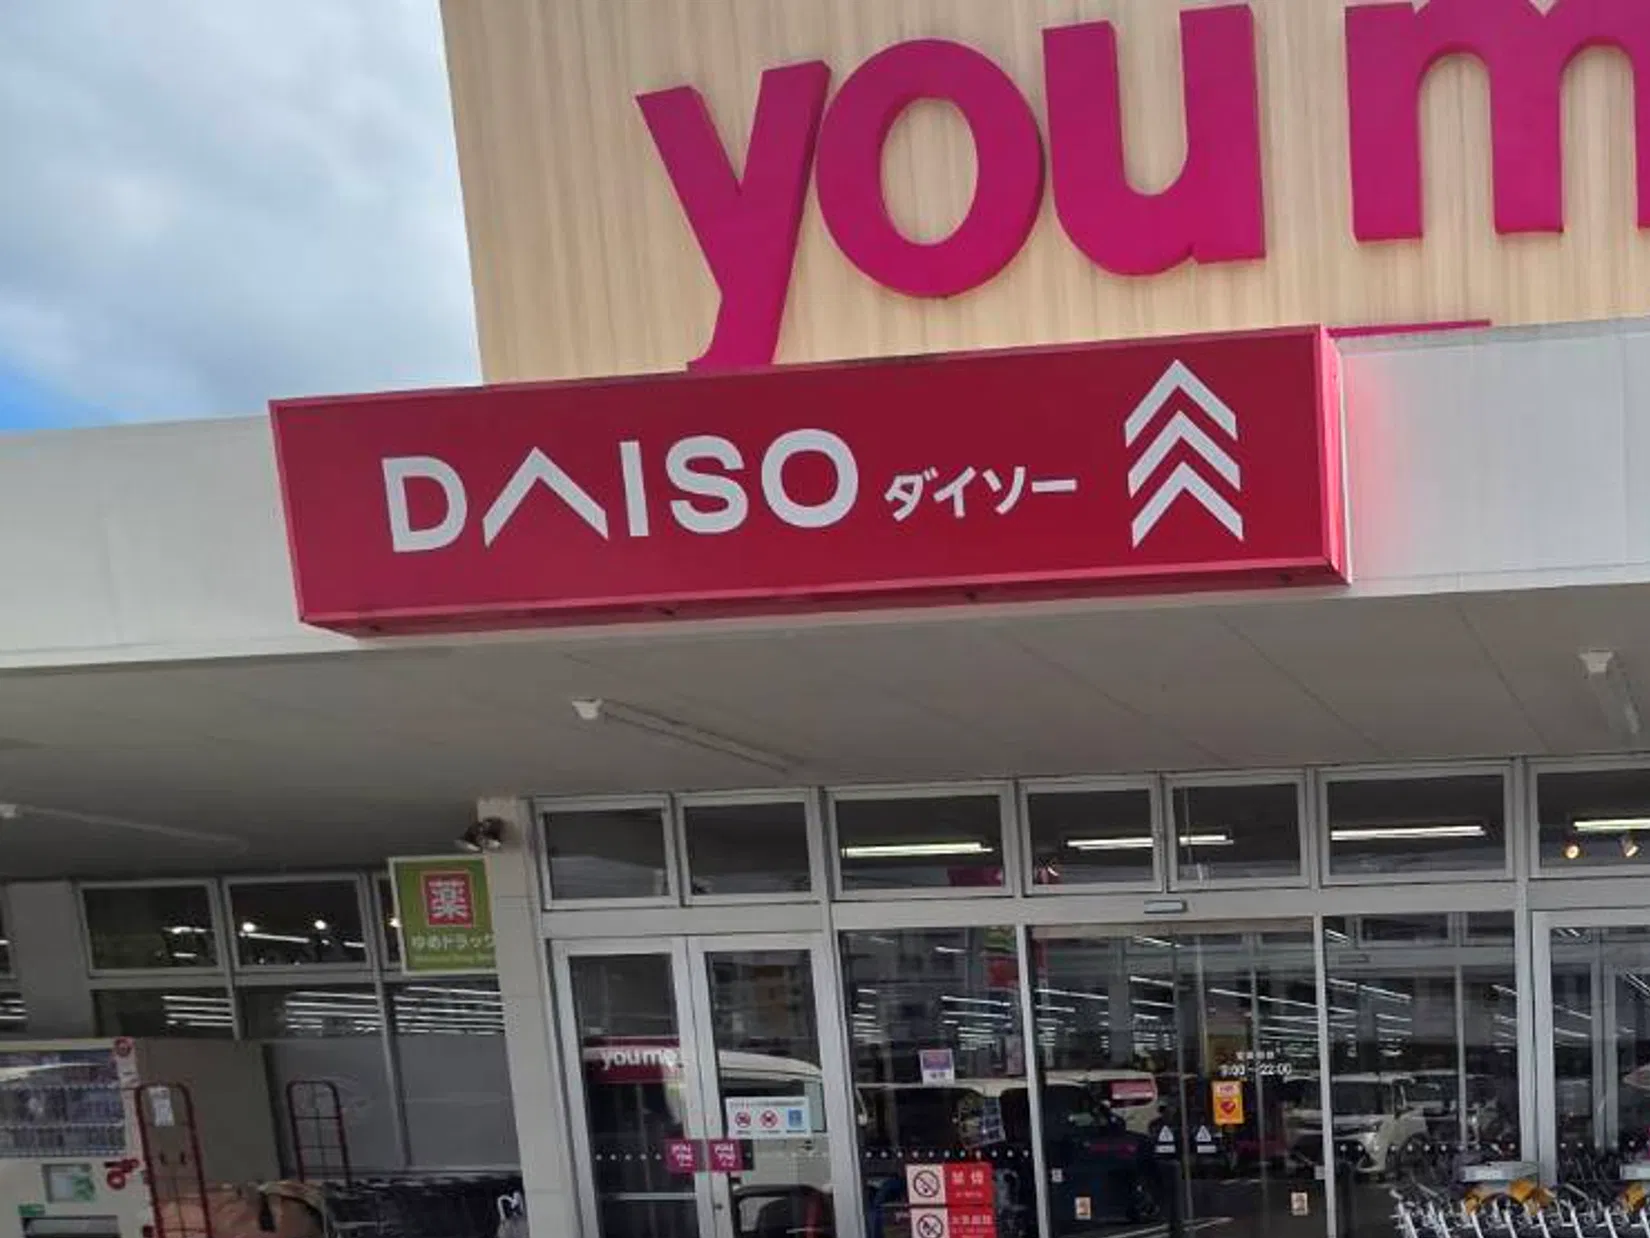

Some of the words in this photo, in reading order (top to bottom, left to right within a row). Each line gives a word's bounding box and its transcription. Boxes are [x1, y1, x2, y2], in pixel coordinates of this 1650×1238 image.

[382, 427, 859, 553] DAISO
[884, 464, 1077, 521] ダイソー
[428, 879, 469, 920] 薬
